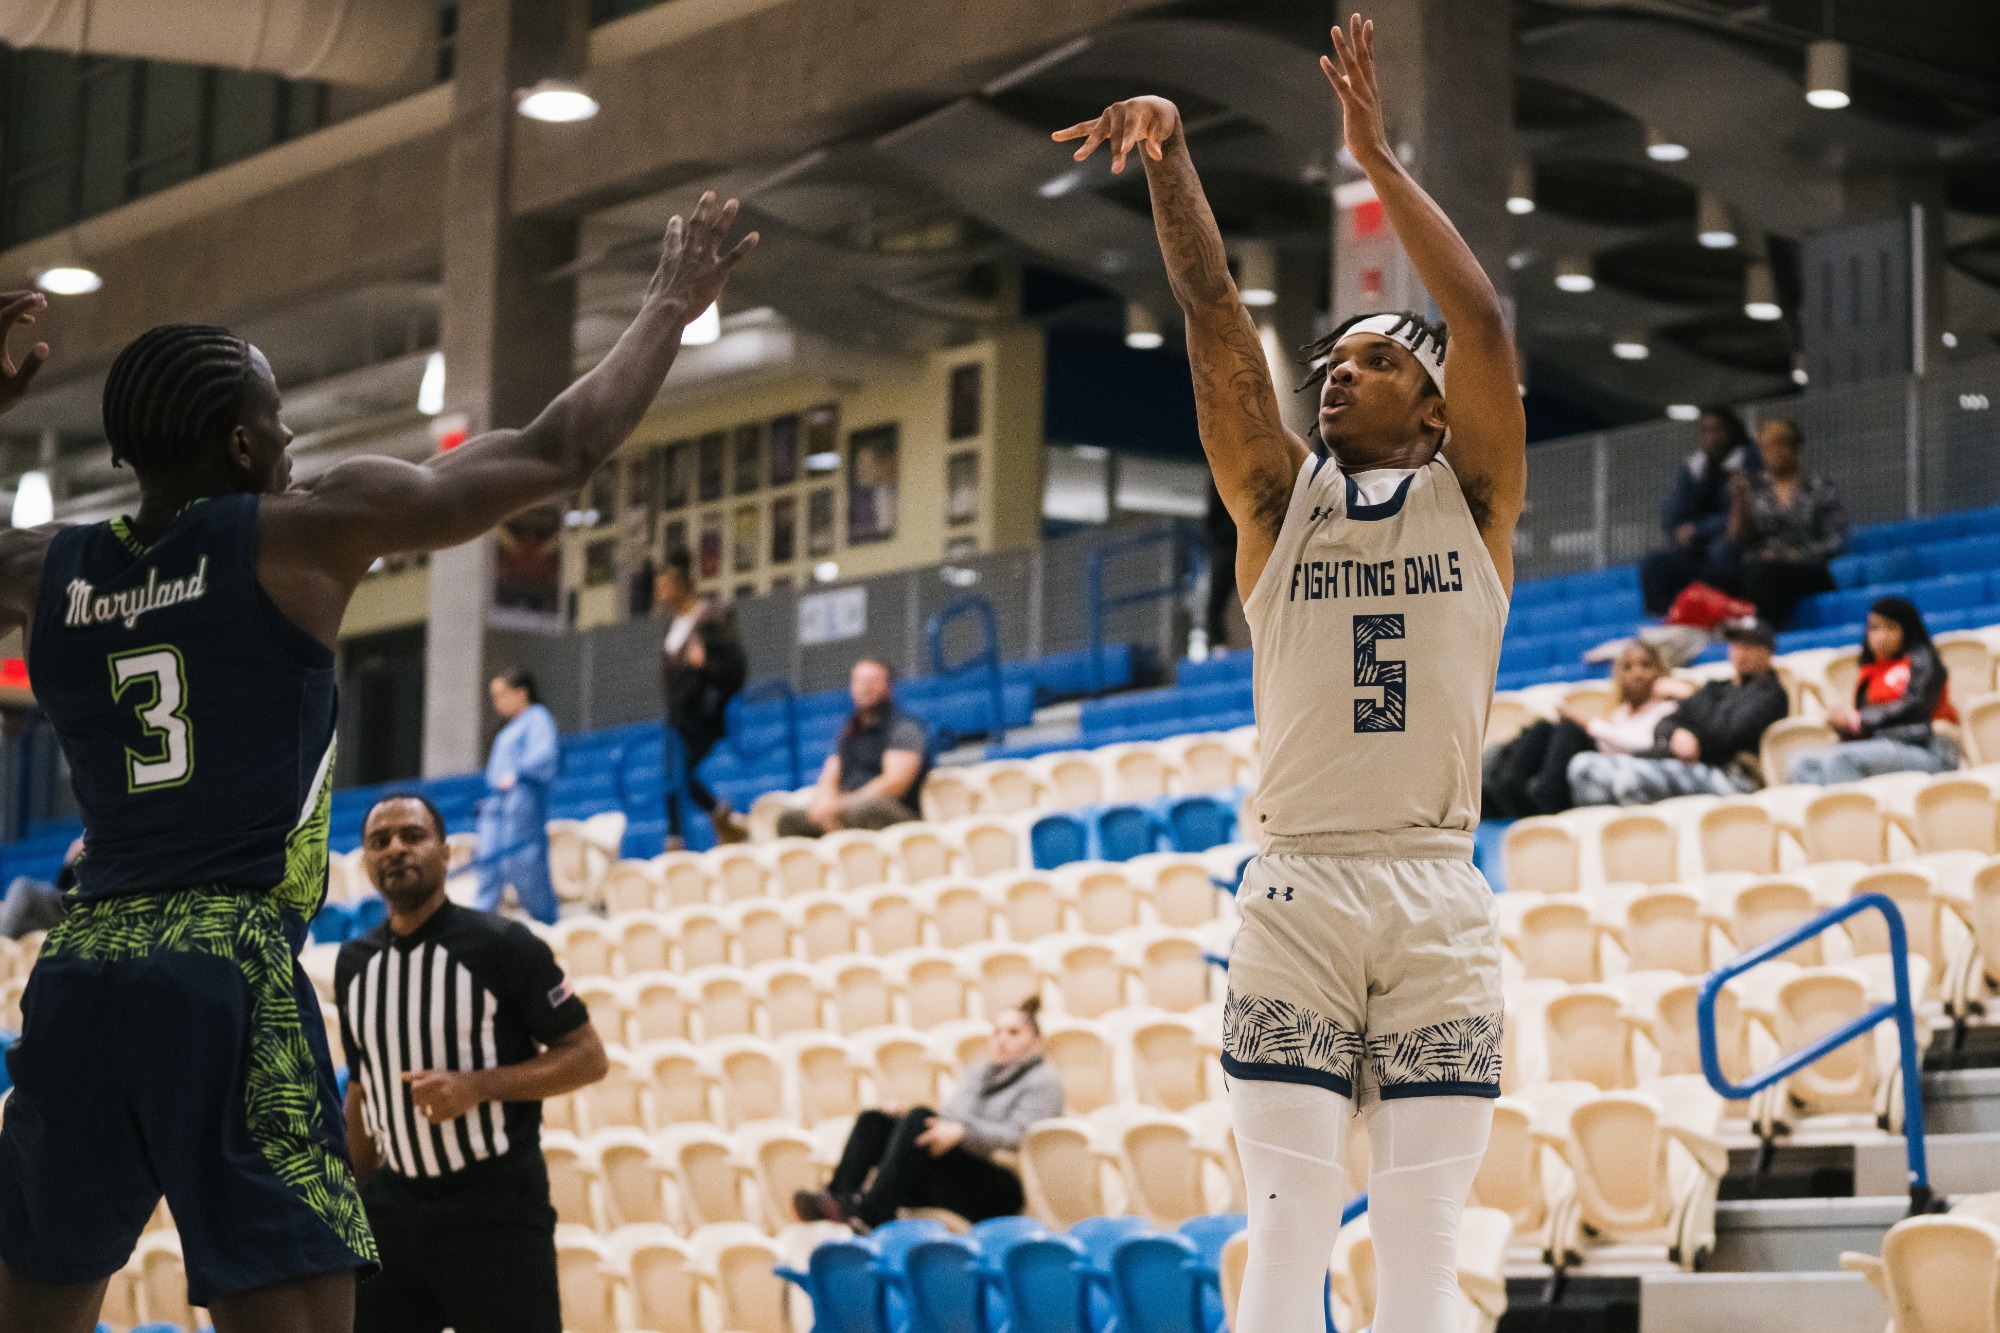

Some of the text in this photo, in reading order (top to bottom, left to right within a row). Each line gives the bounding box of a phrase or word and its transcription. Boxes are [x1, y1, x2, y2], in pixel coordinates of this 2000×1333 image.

[66, 554, 207, 628] Maryland
[1290, 551, 1462, 601] FIGHTING OWLS
[108, 643, 194, 793] 3
[1353, 613, 1405, 733] 5
